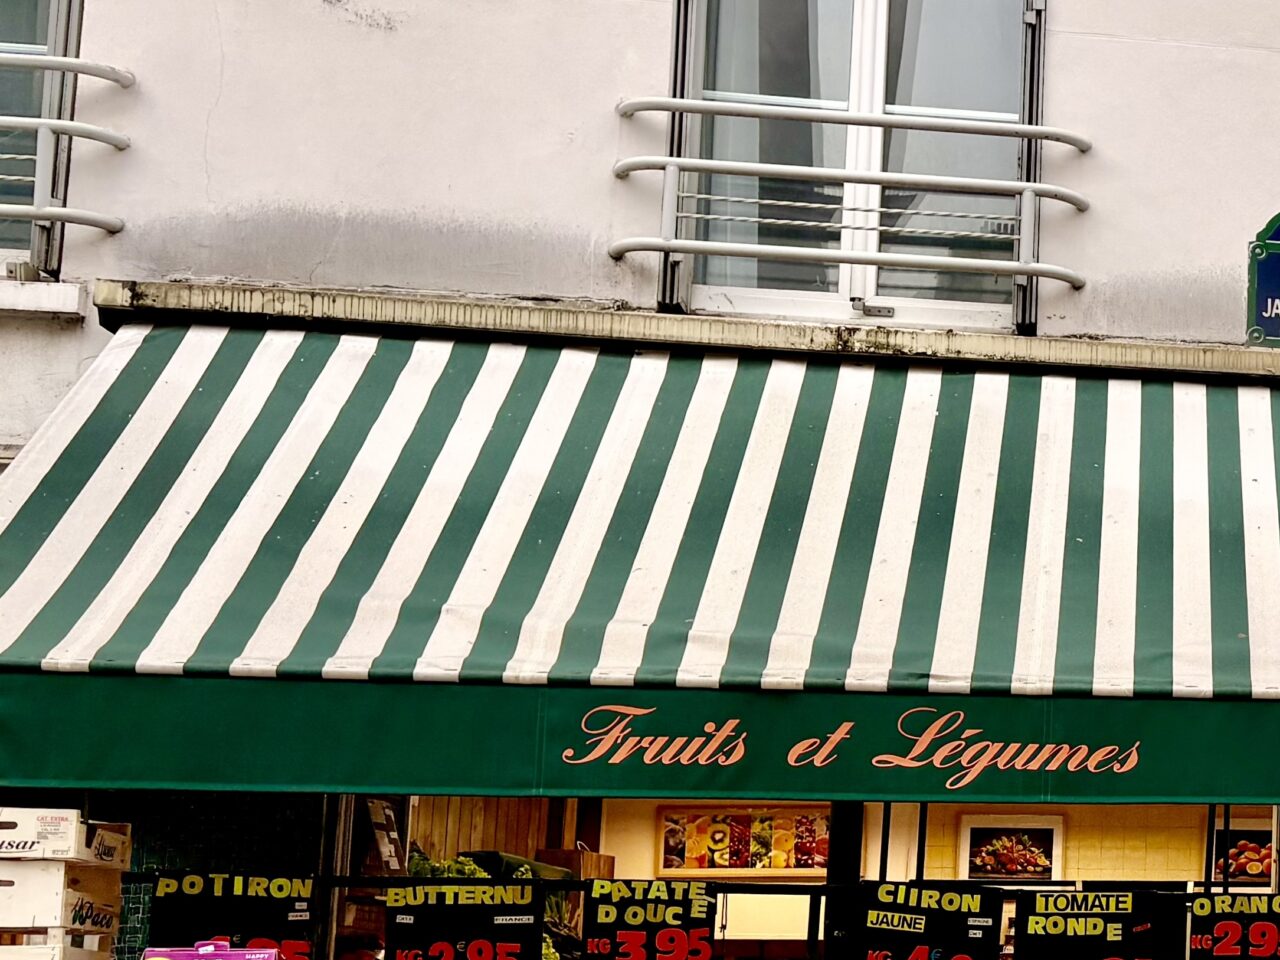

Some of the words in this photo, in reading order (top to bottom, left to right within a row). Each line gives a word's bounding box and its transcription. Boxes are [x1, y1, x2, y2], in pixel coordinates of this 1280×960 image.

[562, 703, 748, 766] Fruits
[787, 721, 856, 767] et
[871, 707, 1141, 789] Légumes
[155, 873, 313, 898] POTIRON
[386, 885, 532, 907] BUTTERNU
[592, 879, 707, 902] PATATE
[597, 899, 708, 925] DOUCE
[1040, 893, 1129, 912] TOMATE
[869, 912, 924, 931] JAUNE
[1027, 916, 1122, 941] RONDE
[587, 938, 611, 954] KG
[1191, 935, 1212, 949] KG
